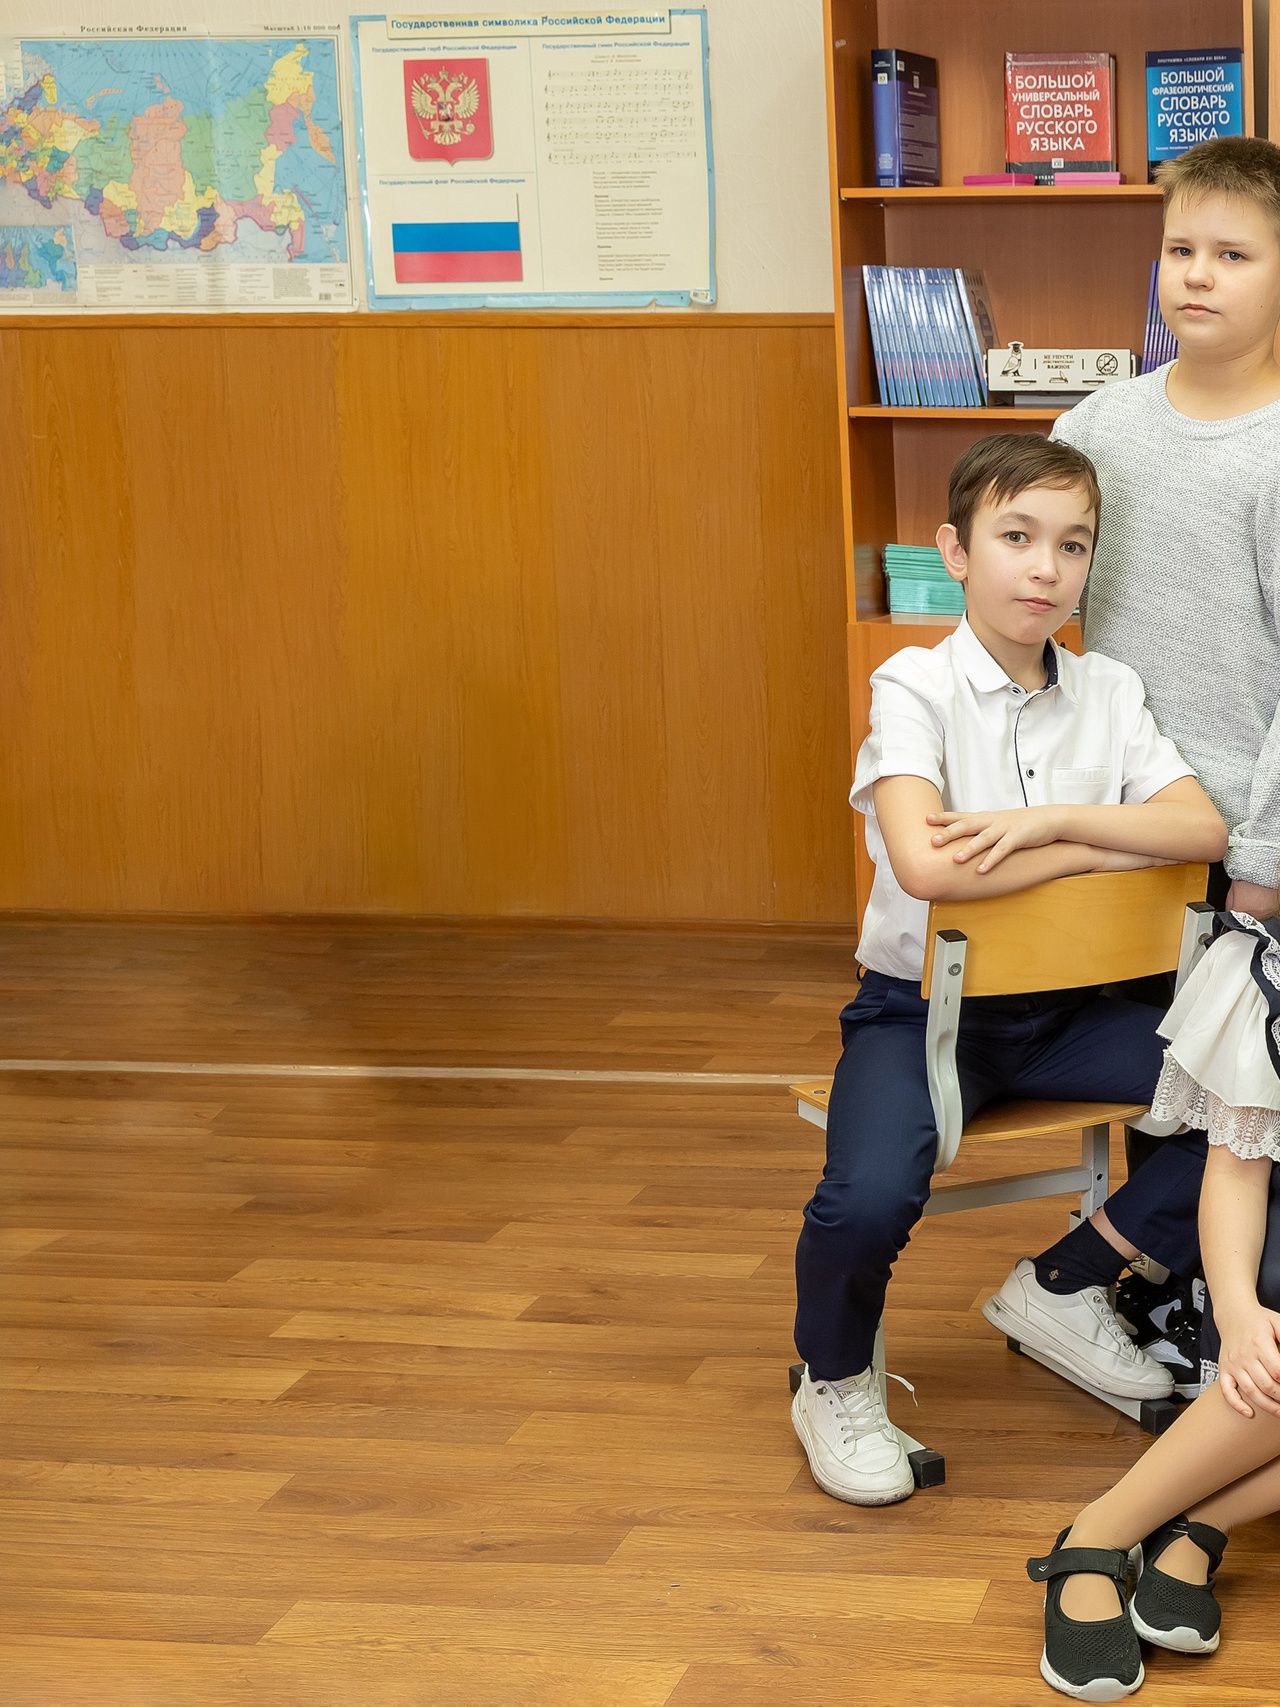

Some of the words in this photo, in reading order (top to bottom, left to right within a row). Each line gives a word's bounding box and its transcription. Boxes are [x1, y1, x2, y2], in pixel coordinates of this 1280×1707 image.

[391, 19, 479, 30] Государственная
[482, 18, 538, 27] символика
[542, 16, 602, 26] Российской
[605, 15, 666, 25] Федерации
[1015, 71, 1096, 90] БОЛЬШОЙ
[1161, 66, 1224, 85] БОЛЬШОЙ
[1011, 89, 1100, 103] УНИВЕРСАЛЬНЫЙ
[1152, 82, 1235, 95] ФРАЗЕОЛОГИЧЕСКИЙ
[1160, 94, 1227, 111] СЛОВАРЬ
[1020, 103, 1093, 119] СЛОВАРЬ
[1157, 110, 1231, 128] РУССКОГО
[1016, 119, 1098, 136] РУССКОГО
[1169, 127, 1219, 143] ЯЗЫКА
[1030, 136, 1085, 152] ЯЗЫКА
